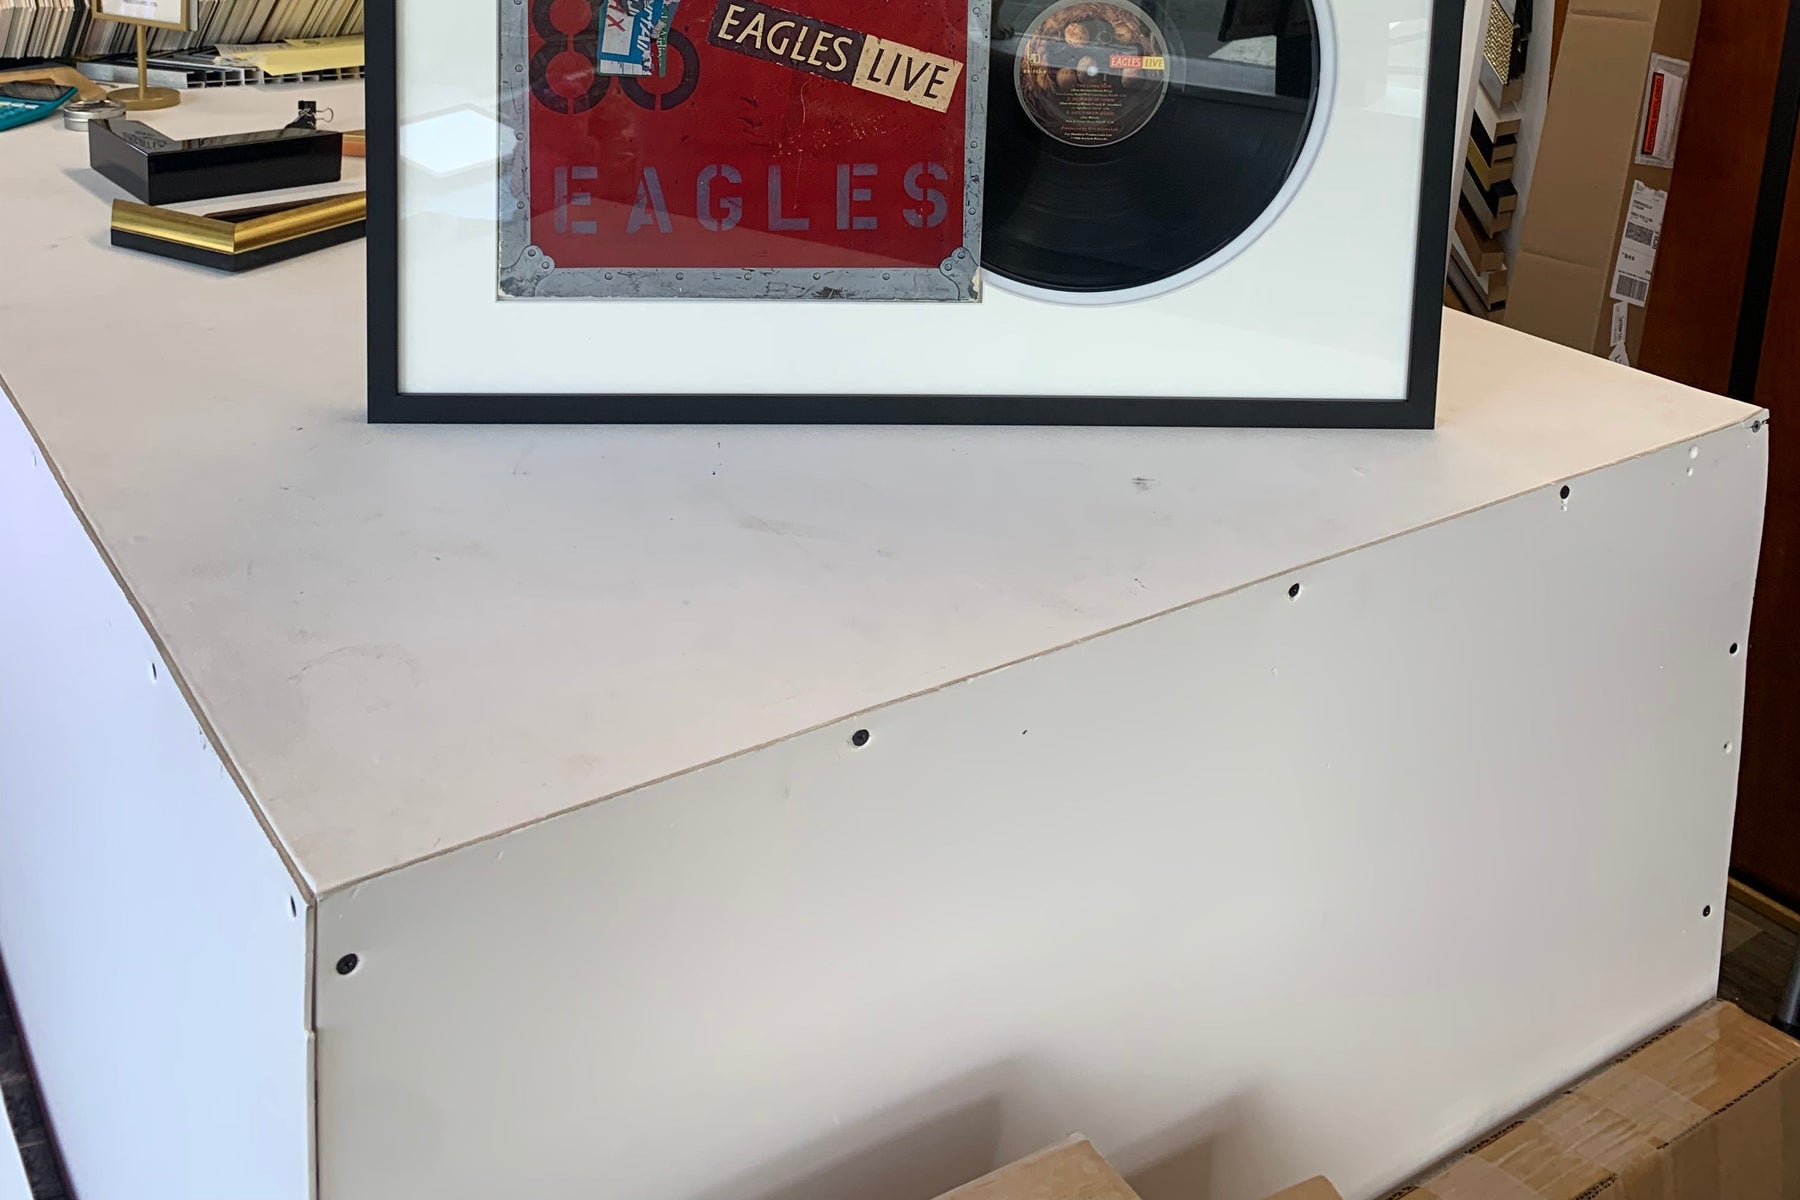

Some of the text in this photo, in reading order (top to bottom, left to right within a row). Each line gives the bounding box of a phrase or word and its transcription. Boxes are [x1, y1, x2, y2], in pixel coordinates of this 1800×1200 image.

[717, 4, 950, 100] EAGLES LIVE
[1111, 57, 1164, 67] EAGLES LIVE
[554, 162, 949, 234] EAGLES
